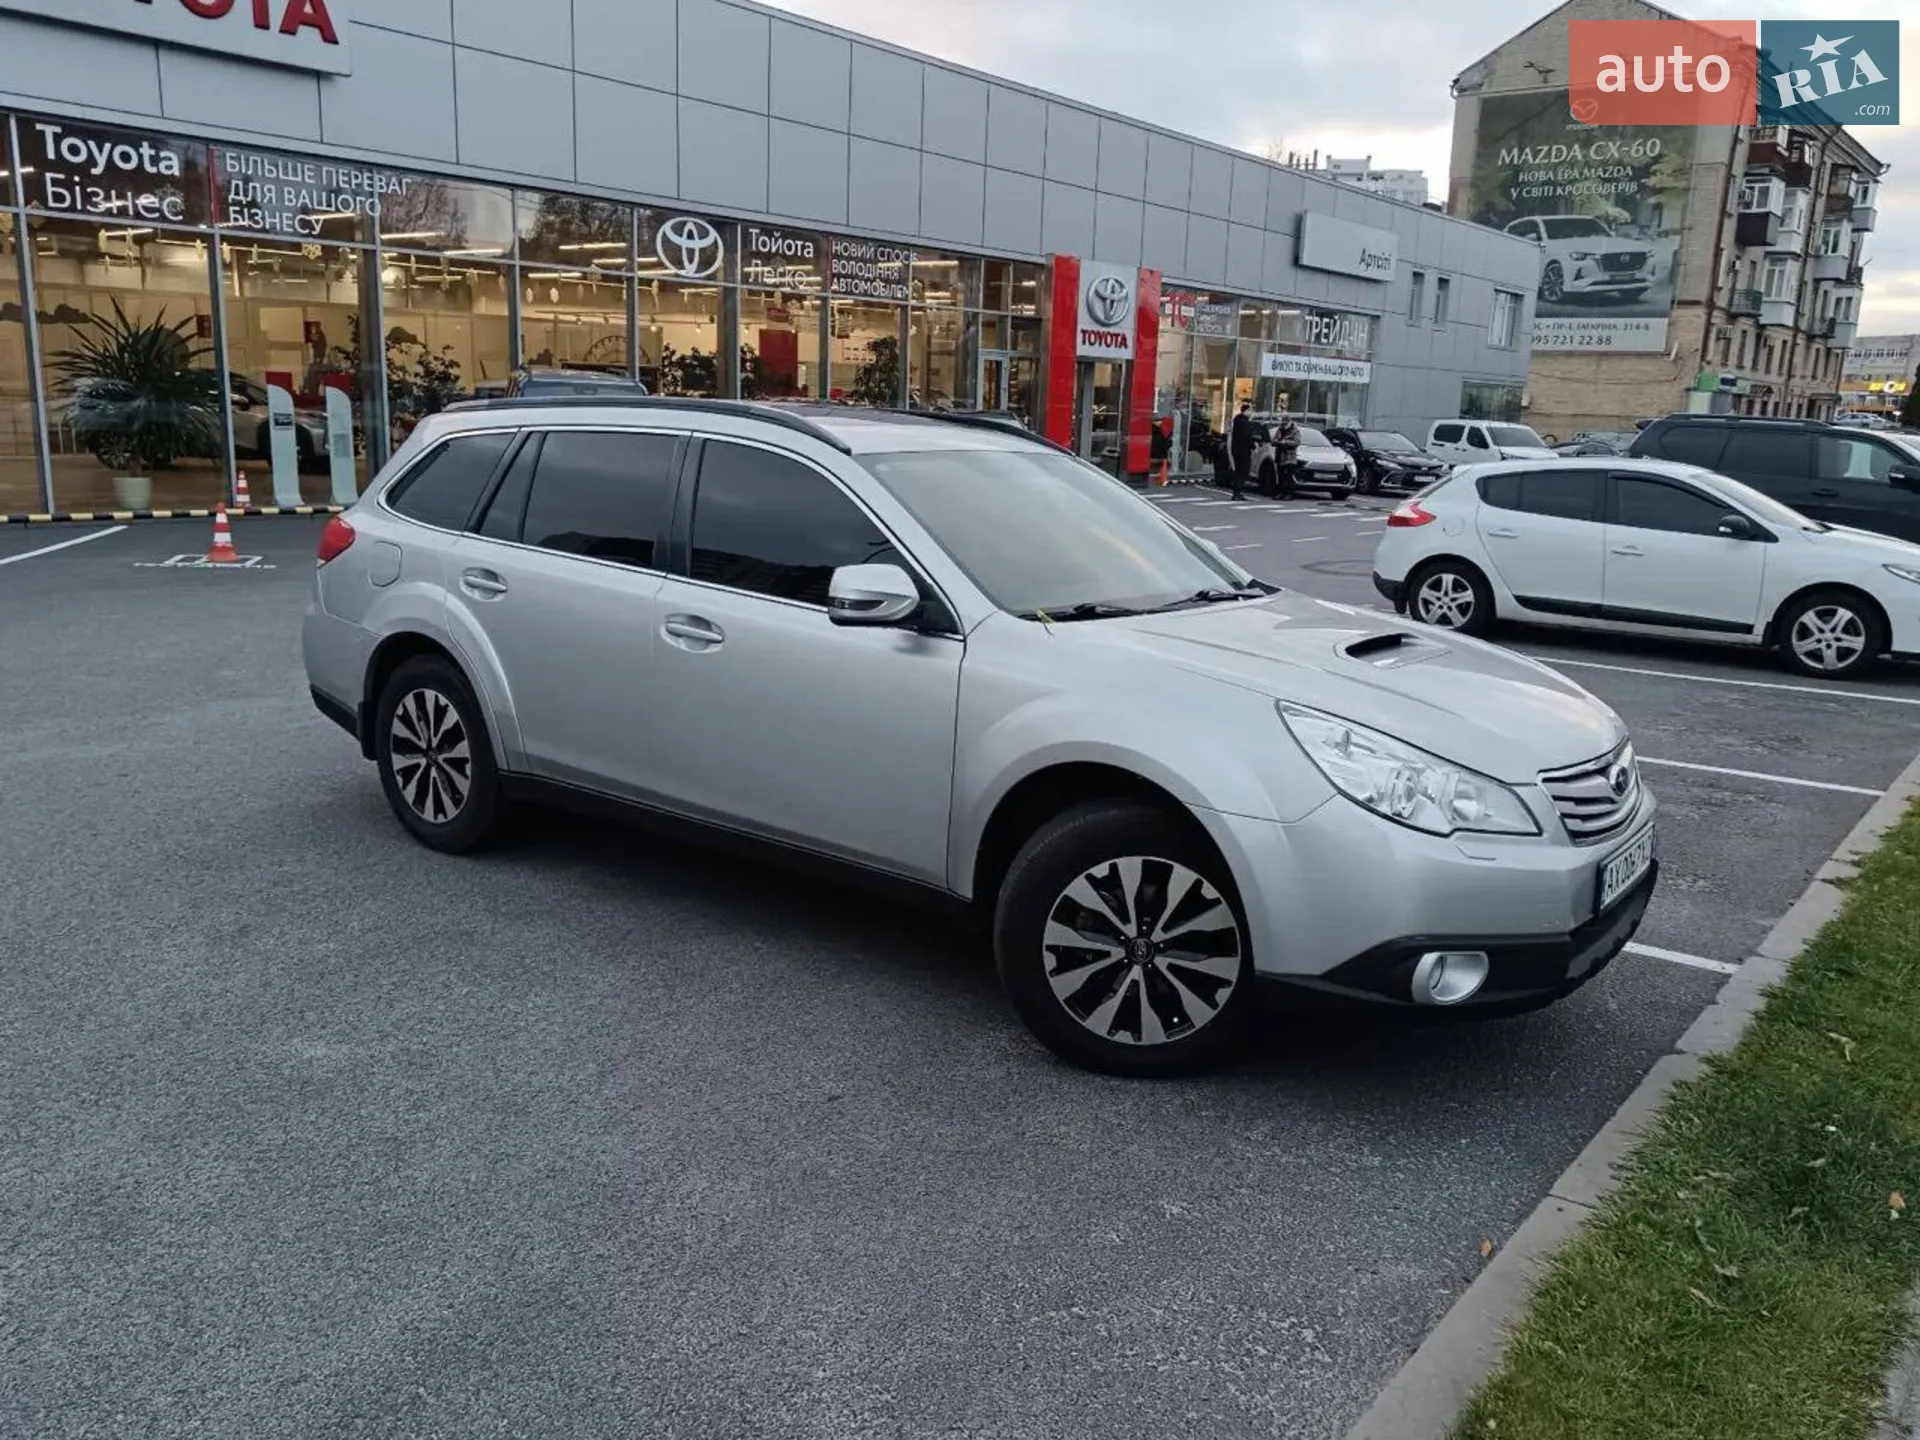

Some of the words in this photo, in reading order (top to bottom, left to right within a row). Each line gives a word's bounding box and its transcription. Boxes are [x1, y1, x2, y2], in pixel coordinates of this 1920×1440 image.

[35, 122, 180, 176] Toyota
[1498, 144, 1583, 166] MAZDA
[1590, 138, 1661, 160] CX-60
[226, 152, 316, 184] БІЛЬШЕ
[322, 167, 412, 196] ПЕРЕВАГ
[1519, 170, 1554, 182] НОВА
[1582, 166, 1633, 179] MAZDA
[44, 172, 183, 221] Бізнес
[228, 180, 276, 205] ДЛЯ
[284, 187, 382, 216] ВАШОГО
[229, 206, 325, 235] БІЗНЕСУ
[748, 228, 814, 258] Тойота
[832, 240, 875, 259] НОВИЙ
[748, 260, 806, 287] Легко
[832, 259, 900, 281] ВОЛОДІННЯ
[1080, 328, 1128, 349] TOYOTA
[1305, 315, 1369, 349] ТРЕЙД-ІН
